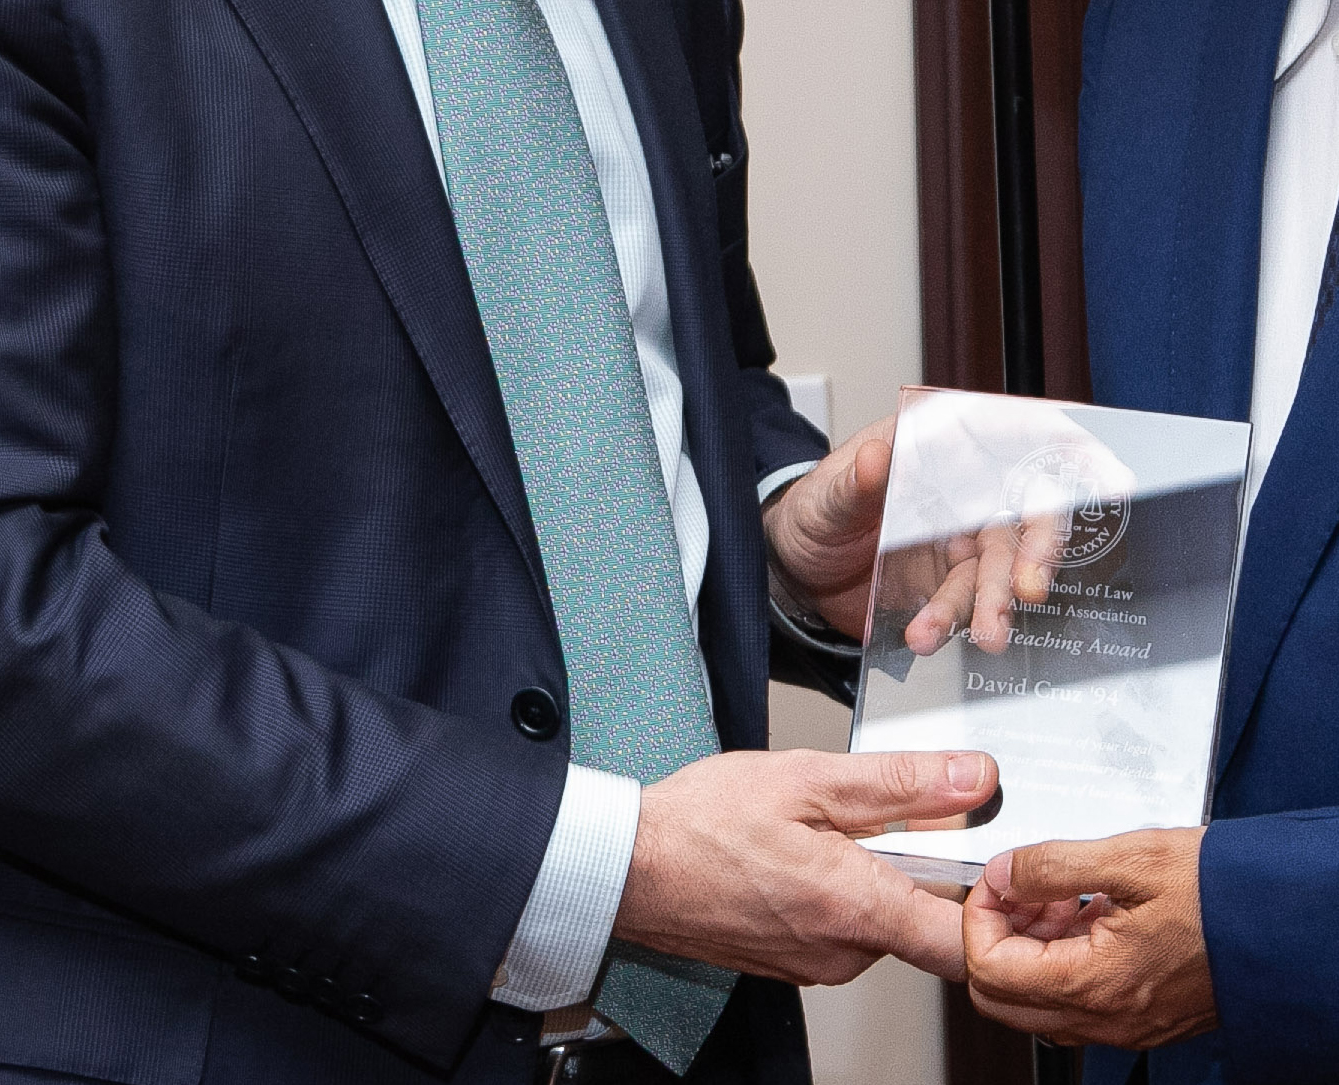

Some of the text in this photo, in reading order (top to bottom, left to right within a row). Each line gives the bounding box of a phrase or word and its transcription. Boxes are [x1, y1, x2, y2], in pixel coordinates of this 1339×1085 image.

[1027, 451, 1064, 473] YORK
[1085, 583, 1103, 598] of
[1104, 585, 1134, 601] Law
[1007, 597, 1061, 616] Alumni
[1065, 603, 1148, 625] Association
[947, 621, 1153, 660] Legal Teaching Award
[966, 671, 1120, 707] David Cruz '94
[1122, 741, 1153, 757] legal
